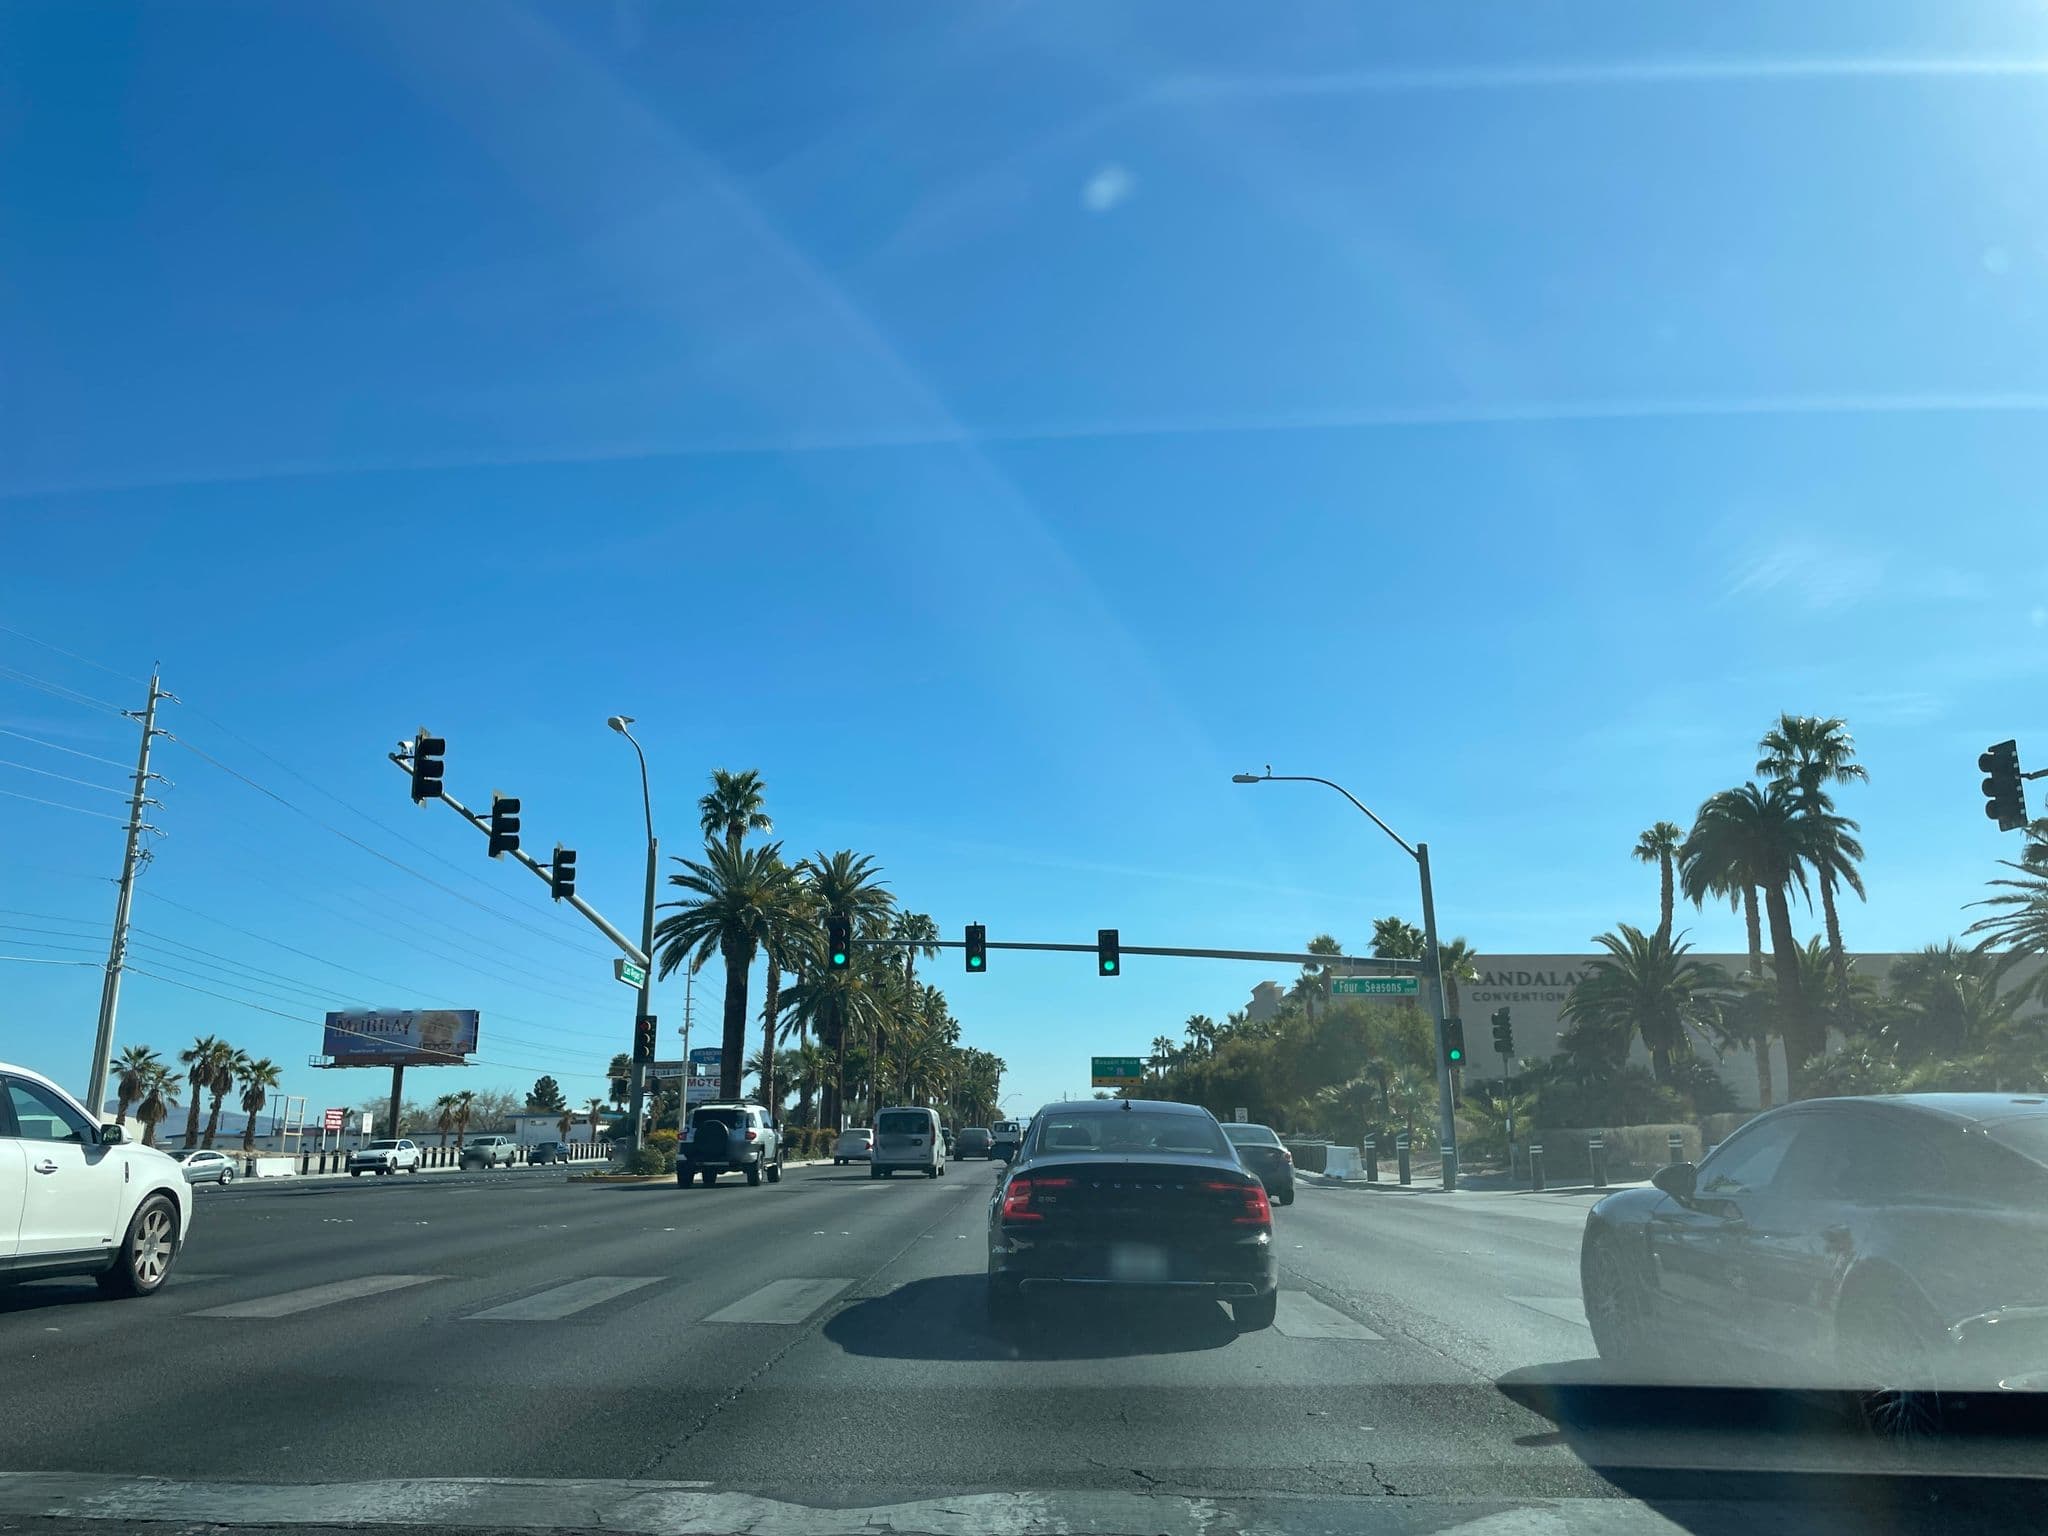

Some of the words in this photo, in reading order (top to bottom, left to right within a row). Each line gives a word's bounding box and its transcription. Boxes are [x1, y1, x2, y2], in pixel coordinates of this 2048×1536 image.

[1340, 981, 1357, 992] Four
[1365, 981, 1402, 992] Seasons
[1472, 992, 1565, 1001] CONVENTION
[687, 1078, 721, 1087] MOTE
